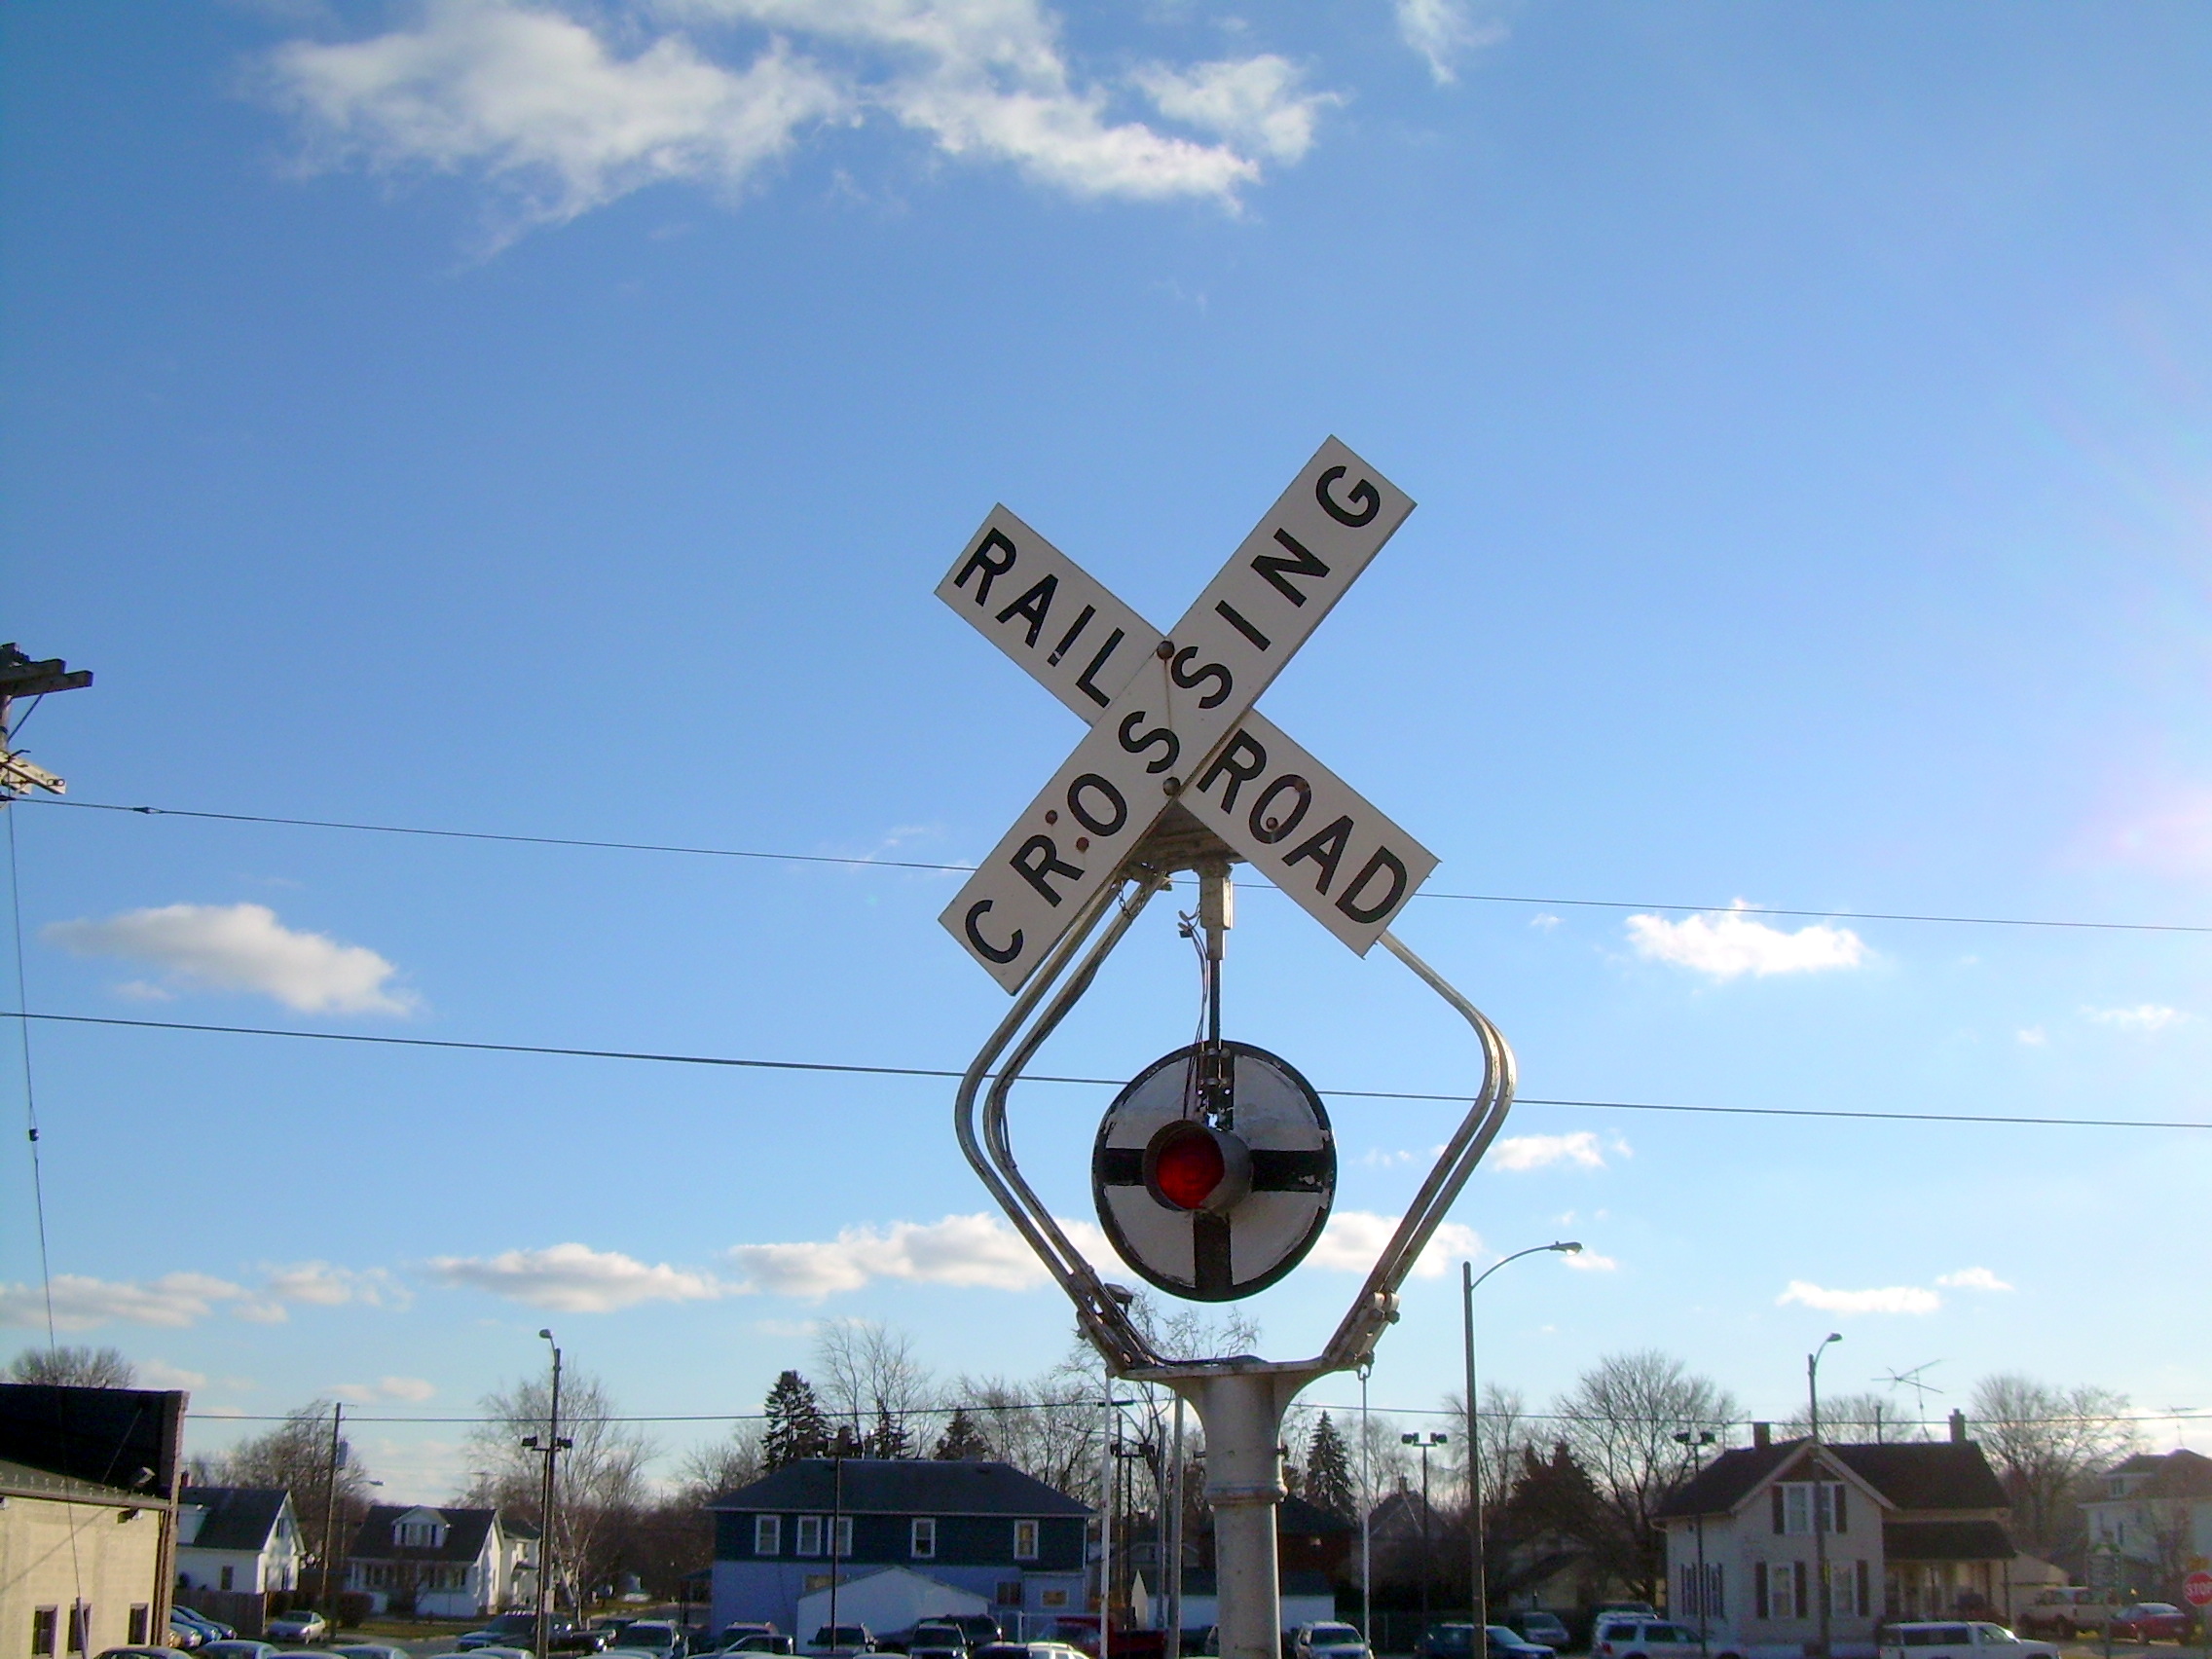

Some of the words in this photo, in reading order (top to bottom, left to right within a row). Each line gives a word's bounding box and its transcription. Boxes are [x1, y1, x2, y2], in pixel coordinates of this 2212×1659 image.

[954, 527, 1124, 708] RAIL
[1197, 728, 1408, 925] ROAD
[965, 465, 1381, 964] CROSSING
